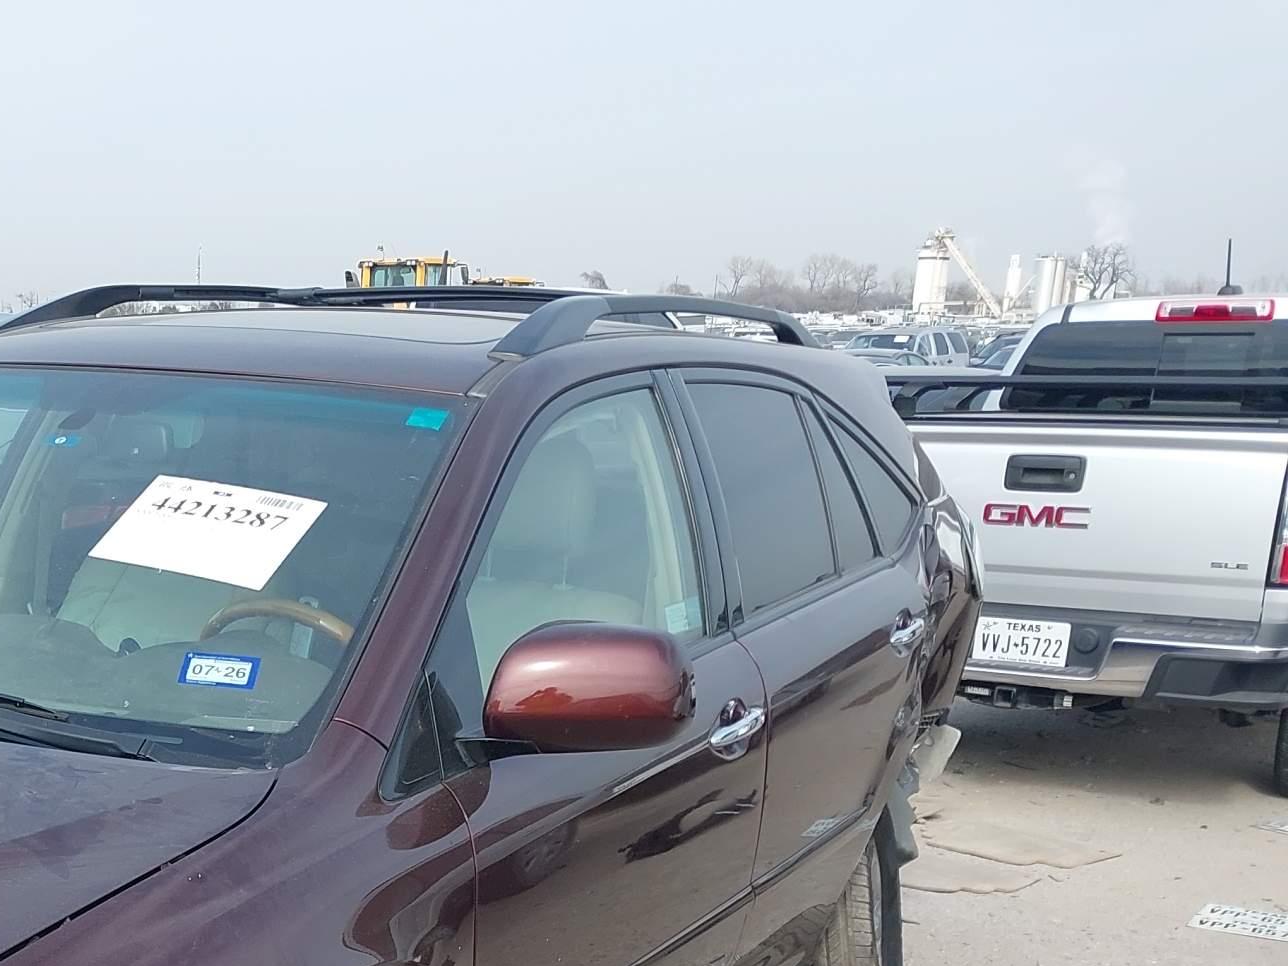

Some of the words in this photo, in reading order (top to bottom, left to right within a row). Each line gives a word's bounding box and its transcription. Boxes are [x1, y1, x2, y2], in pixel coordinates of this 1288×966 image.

[152, 497, 288, 530] 44213287
[983, 503, 1092, 529] GMC
[1210, 561, 1249, 570] SLE
[1006, 622, 1041, 633] TEXAS
[192, 664, 215, 676] 07
[223, 666, 248, 679] 26
